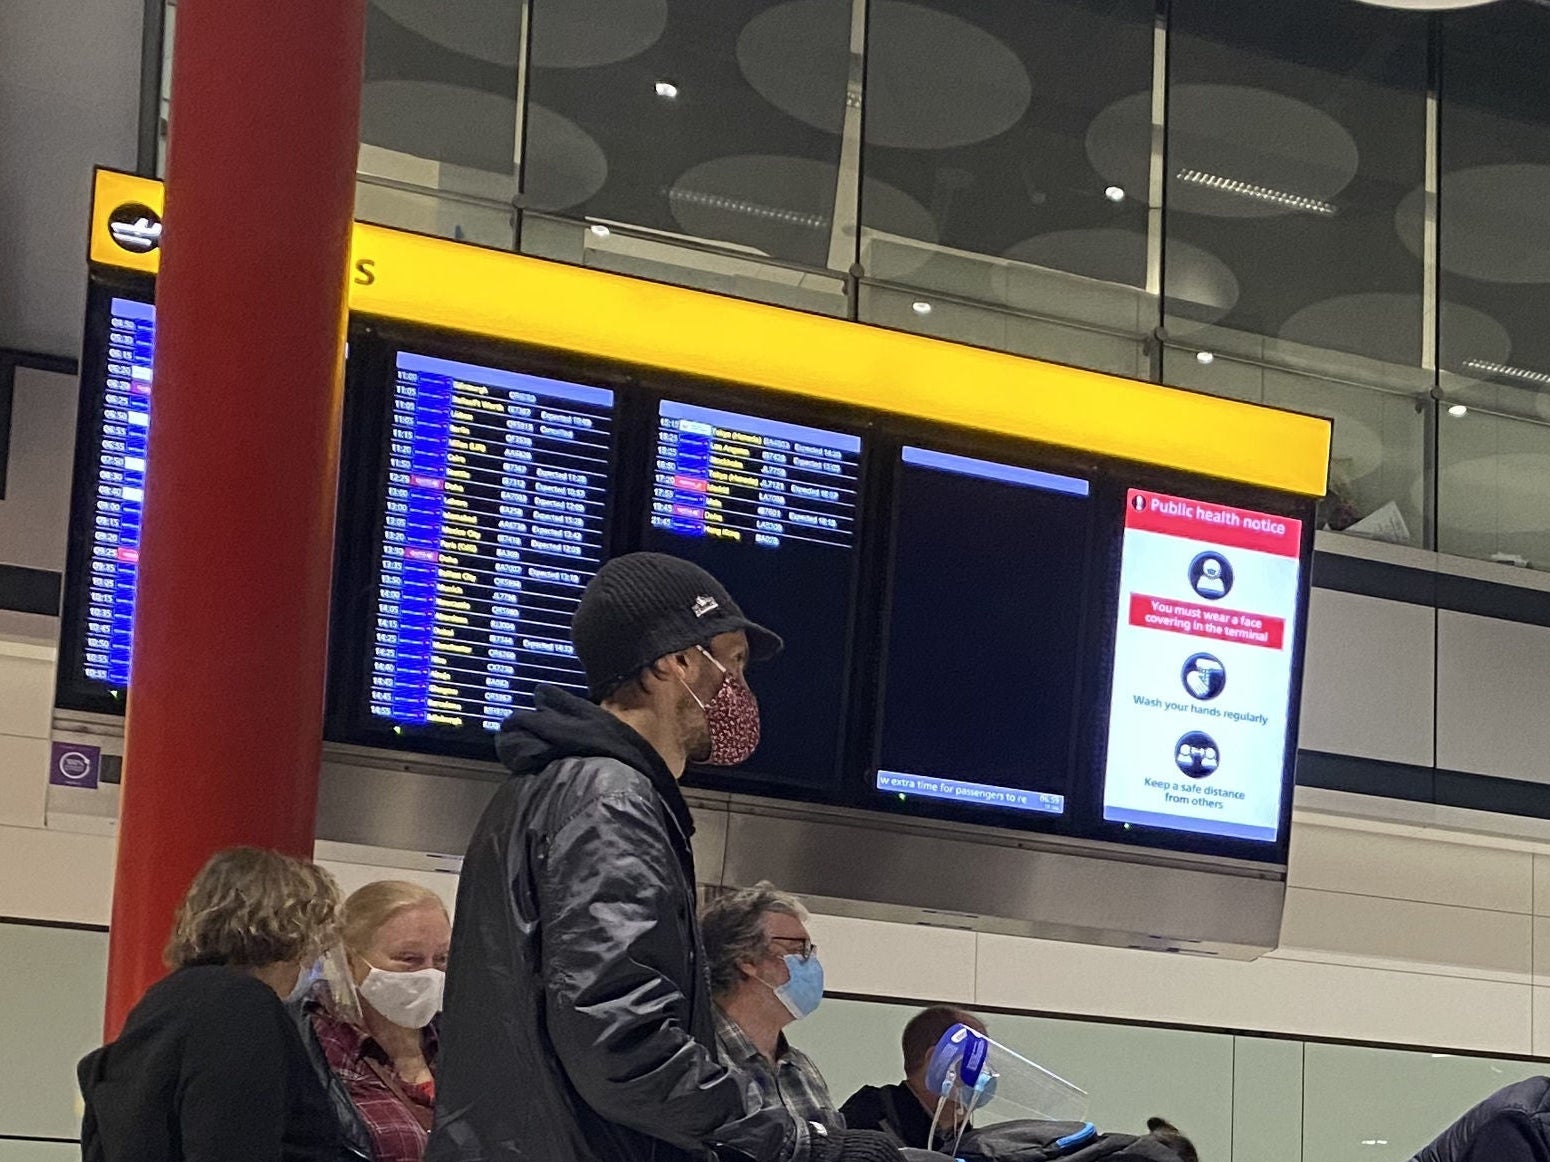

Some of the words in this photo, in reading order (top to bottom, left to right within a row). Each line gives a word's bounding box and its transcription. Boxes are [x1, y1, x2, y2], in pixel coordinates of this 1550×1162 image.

[396, 385, 416, 395] 11:05
[393, 429, 412, 439] 11:15
[389, 472, 409, 483] 12:25
[1150, 498, 1193, 518] Public
[1196, 506, 1240, 526] health
[1243, 518, 1286, 535] notice
[1152, 600, 1172, 614] You
[1175, 606, 1201, 618] must
[1204, 612, 1229, 622] wear
[1240, 616, 1262, 628] face
[1145, 615, 1190, 632] covering
[1194, 619, 1203, 630] in
[1205, 621, 1222, 634] the
[1225, 625, 1268, 642] terminal
[1133, 695, 1162, 708] Wash
[1164, 702, 1188, 711] your
[1191, 705, 1221, 717] hands
[1224, 711, 1268, 726] regularly
[891, 778, 915, 788] extra
[917, 780, 938, 791] time
[940, 782, 953, 793] for
[956, 787, 1004, 800] passengers
[1006, 793, 1015, 802] to
[1144, 778, 1170, 790] Keep
[1182, 783, 1201, 793] safe
[1204, 784, 1246, 800] distance
[1165, 794, 1189, 804] from
[1192, 797, 1224, 809] others
